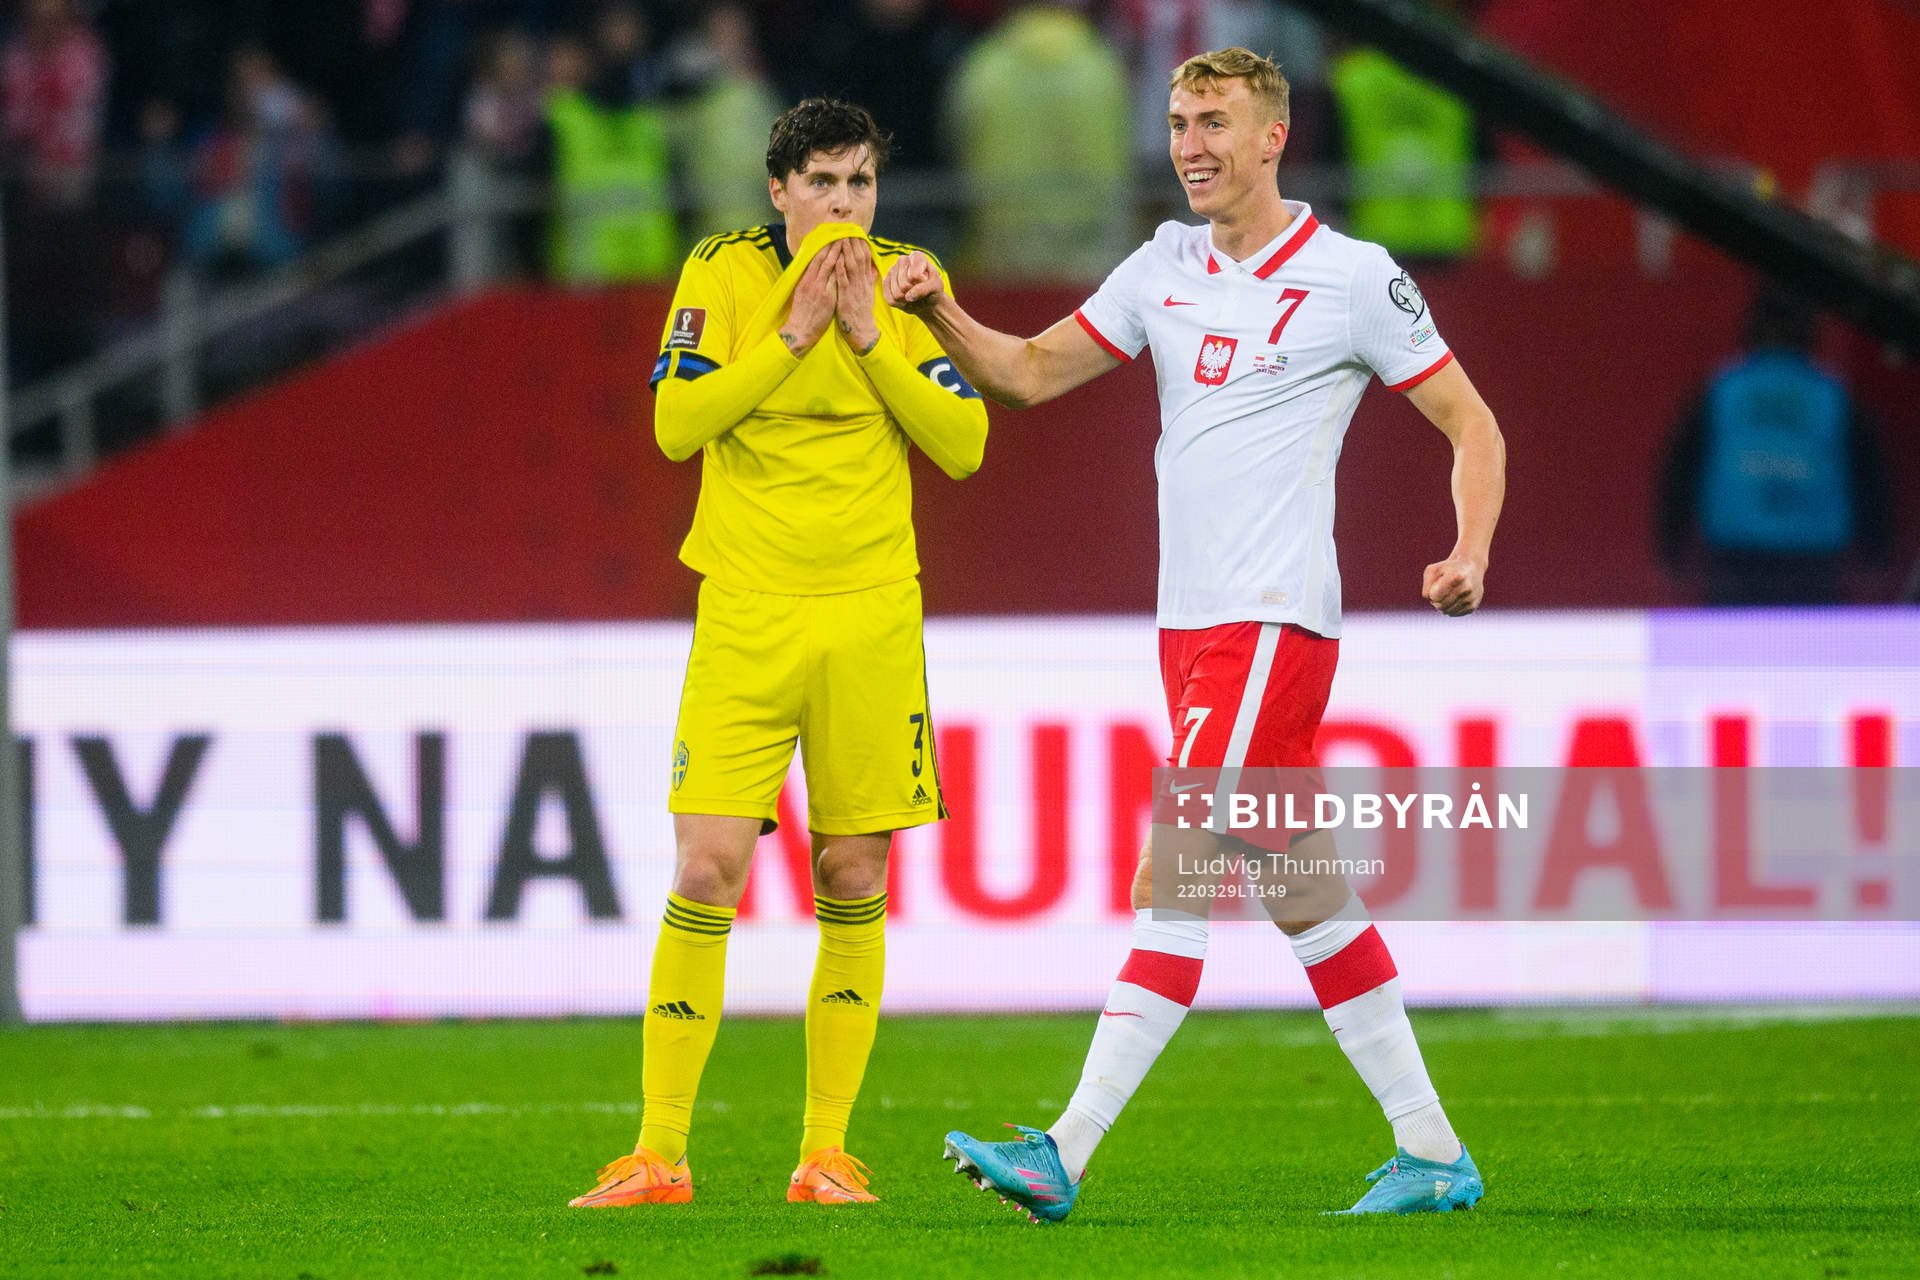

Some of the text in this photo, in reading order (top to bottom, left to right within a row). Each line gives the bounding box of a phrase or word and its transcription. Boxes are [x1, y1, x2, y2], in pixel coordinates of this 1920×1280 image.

[1267, 288, 1310, 345] 7
[930, 363, 961, 393] C
[909, 712, 924, 778] 3
[1178, 707, 1213, 768] 7
[16, 731, 213, 926] Y
[311, 729, 625, 924] NA
[652, 1006, 705, 1020] adidas
[821, 996, 870, 1007] adidas
